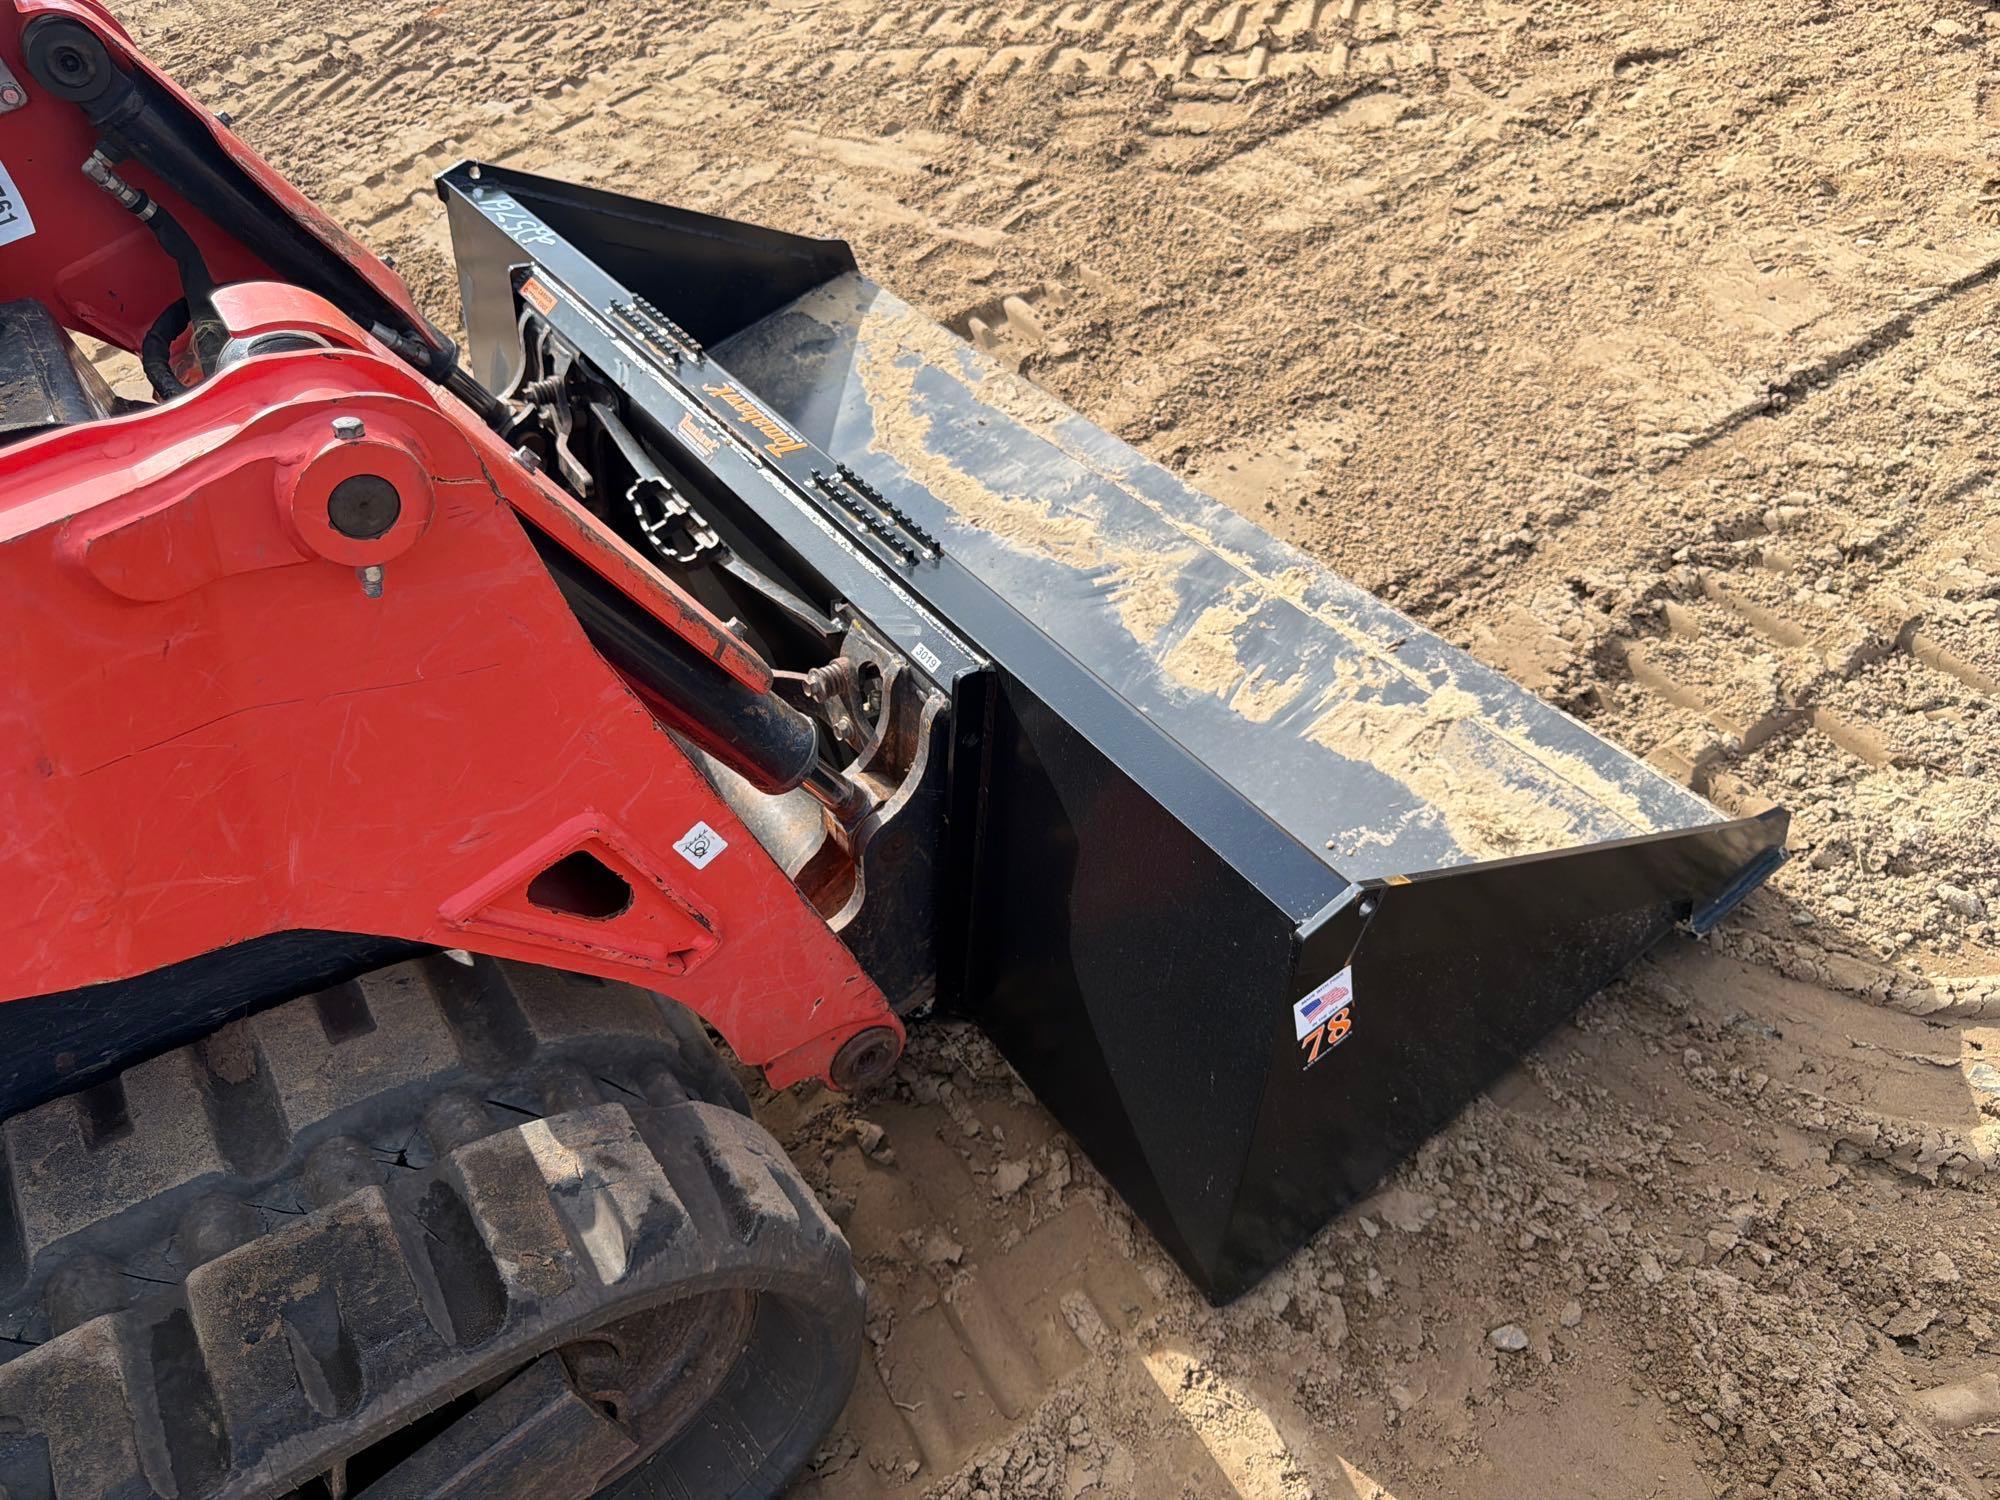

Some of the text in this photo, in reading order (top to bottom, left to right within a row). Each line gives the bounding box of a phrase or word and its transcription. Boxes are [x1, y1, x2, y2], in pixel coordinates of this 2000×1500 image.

[0, 185, 18, 226] 61
[915, 646, 937, 669] 3019
[1301, 1007, 1352, 1063] 78
